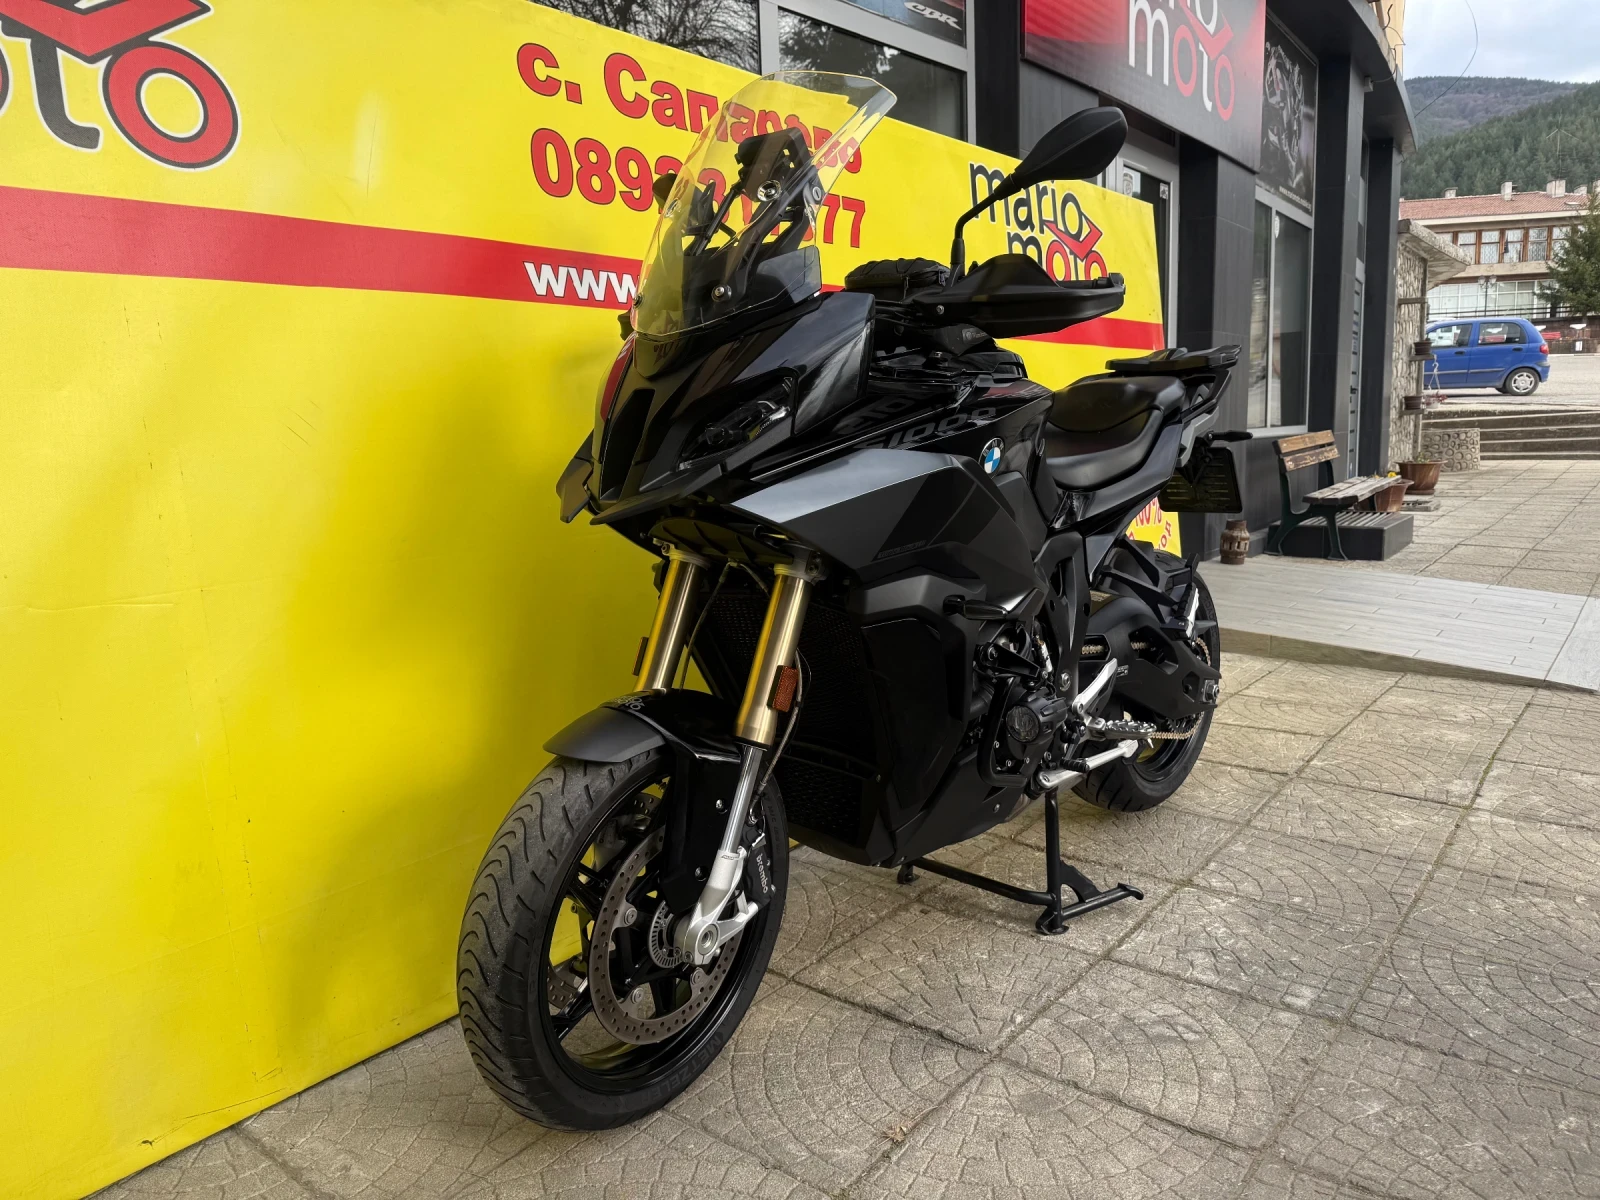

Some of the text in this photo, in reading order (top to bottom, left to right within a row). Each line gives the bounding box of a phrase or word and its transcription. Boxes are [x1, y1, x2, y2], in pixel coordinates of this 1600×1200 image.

[1129, 0, 1235, 121] moto
[969, 162, 1084, 239] mario
[756, 853, 768, 893] brembo
